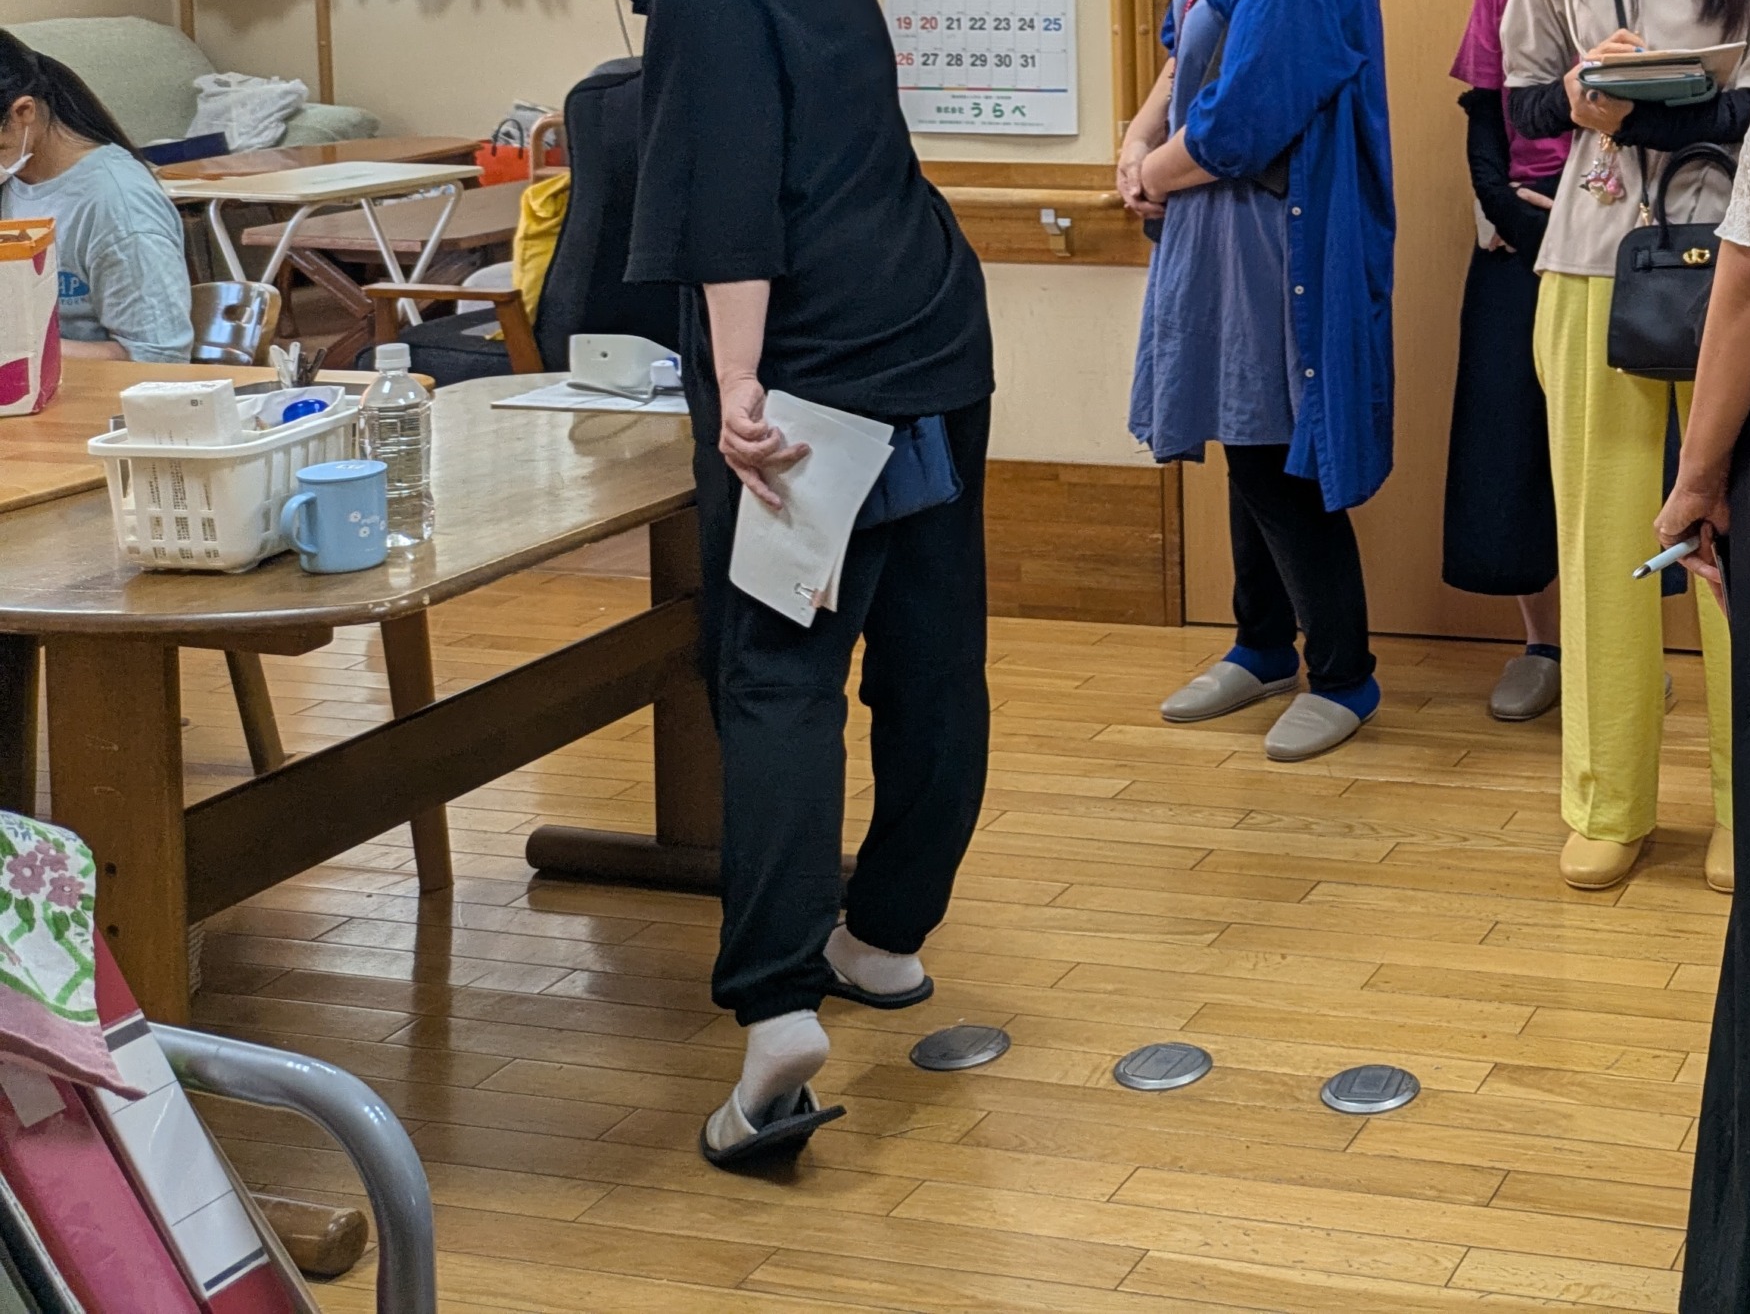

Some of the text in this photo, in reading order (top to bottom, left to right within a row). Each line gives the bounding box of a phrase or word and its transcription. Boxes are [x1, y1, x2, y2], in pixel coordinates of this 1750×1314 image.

[895, 15, 1063, 32] 19 20 21 22 23 24 25
[896, 52, 1036, 69] 26 27 28 29 30 31
[970, 101, 1026, 119] うらべ
